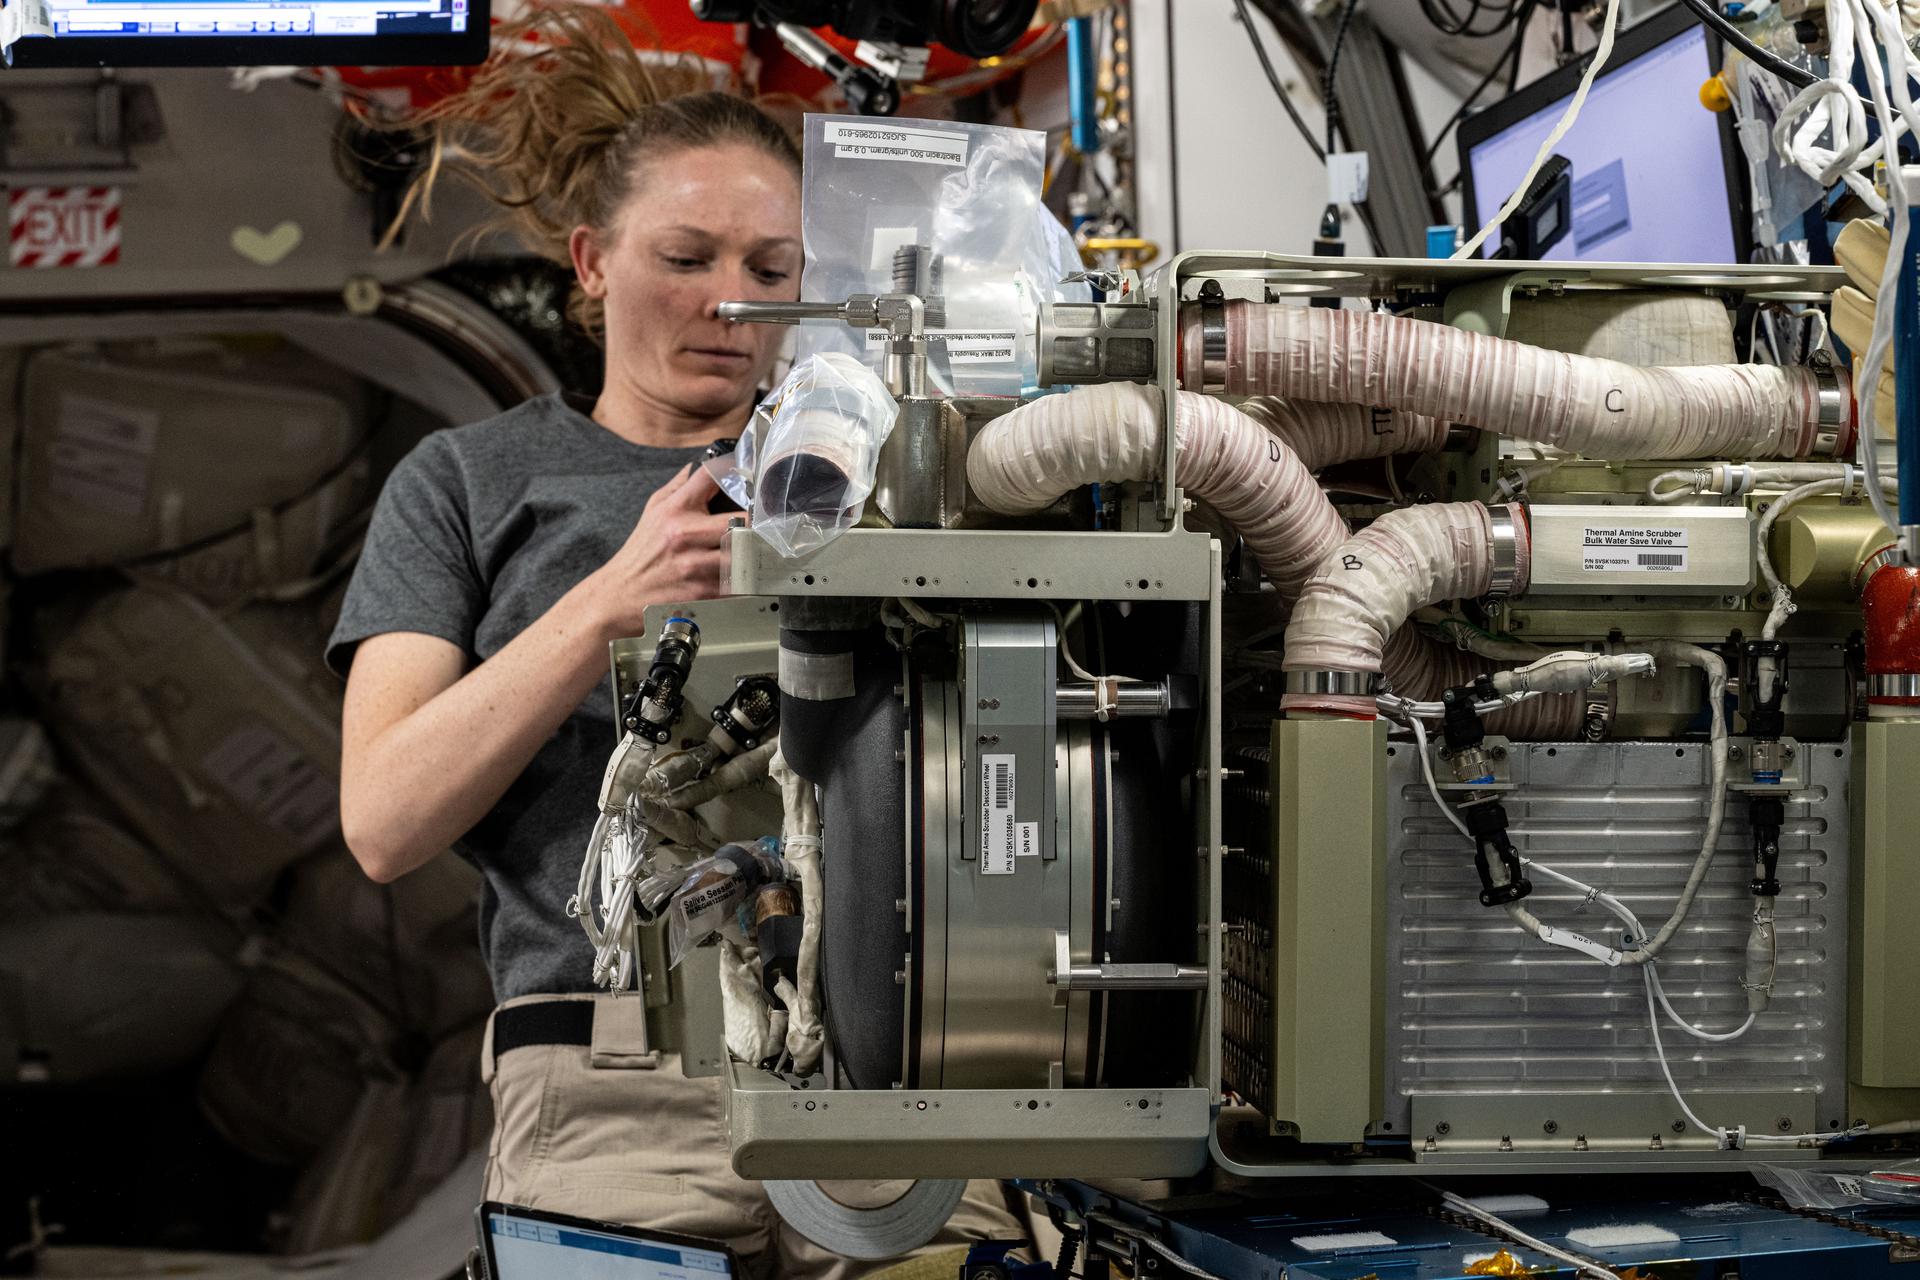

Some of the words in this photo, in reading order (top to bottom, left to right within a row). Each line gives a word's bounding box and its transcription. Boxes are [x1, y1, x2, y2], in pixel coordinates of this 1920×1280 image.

[840, 145, 853, 153] gm
[910, 149, 924, 158] 500
[926, 151, 961, 162] Bacitracin
[25, 203, 102, 245] EXIT
[964, 333, 990, 341] Response
[1605, 388, 1625, 413] C
[1372, 407, 1394, 436] E
[1268, 439, 1281, 463] D
[1585, 529, 1617, 537] Thermal
[1619, 529, 1645, 537] Amine
[1646, 530, 1682, 538] Scrubber
[1585, 537, 1603, 545] Bulk
[1605, 537, 1628, 545] Water
[1629, 537, 1649, 545] Save
[1651, 538, 1673, 546] Valve
[1342, 554, 1363, 571] B
[982, 763, 990, 780] Wheel
[982, 780, 990, 807] Desiccant
[982, 807, 990, 832] Scrubber
[982, 832, 990, 850] Amine
[982, 851, 990, 872] Thermal
[684, 894, 706, 910] Saliva
[706, 881, 734, 899] Session
